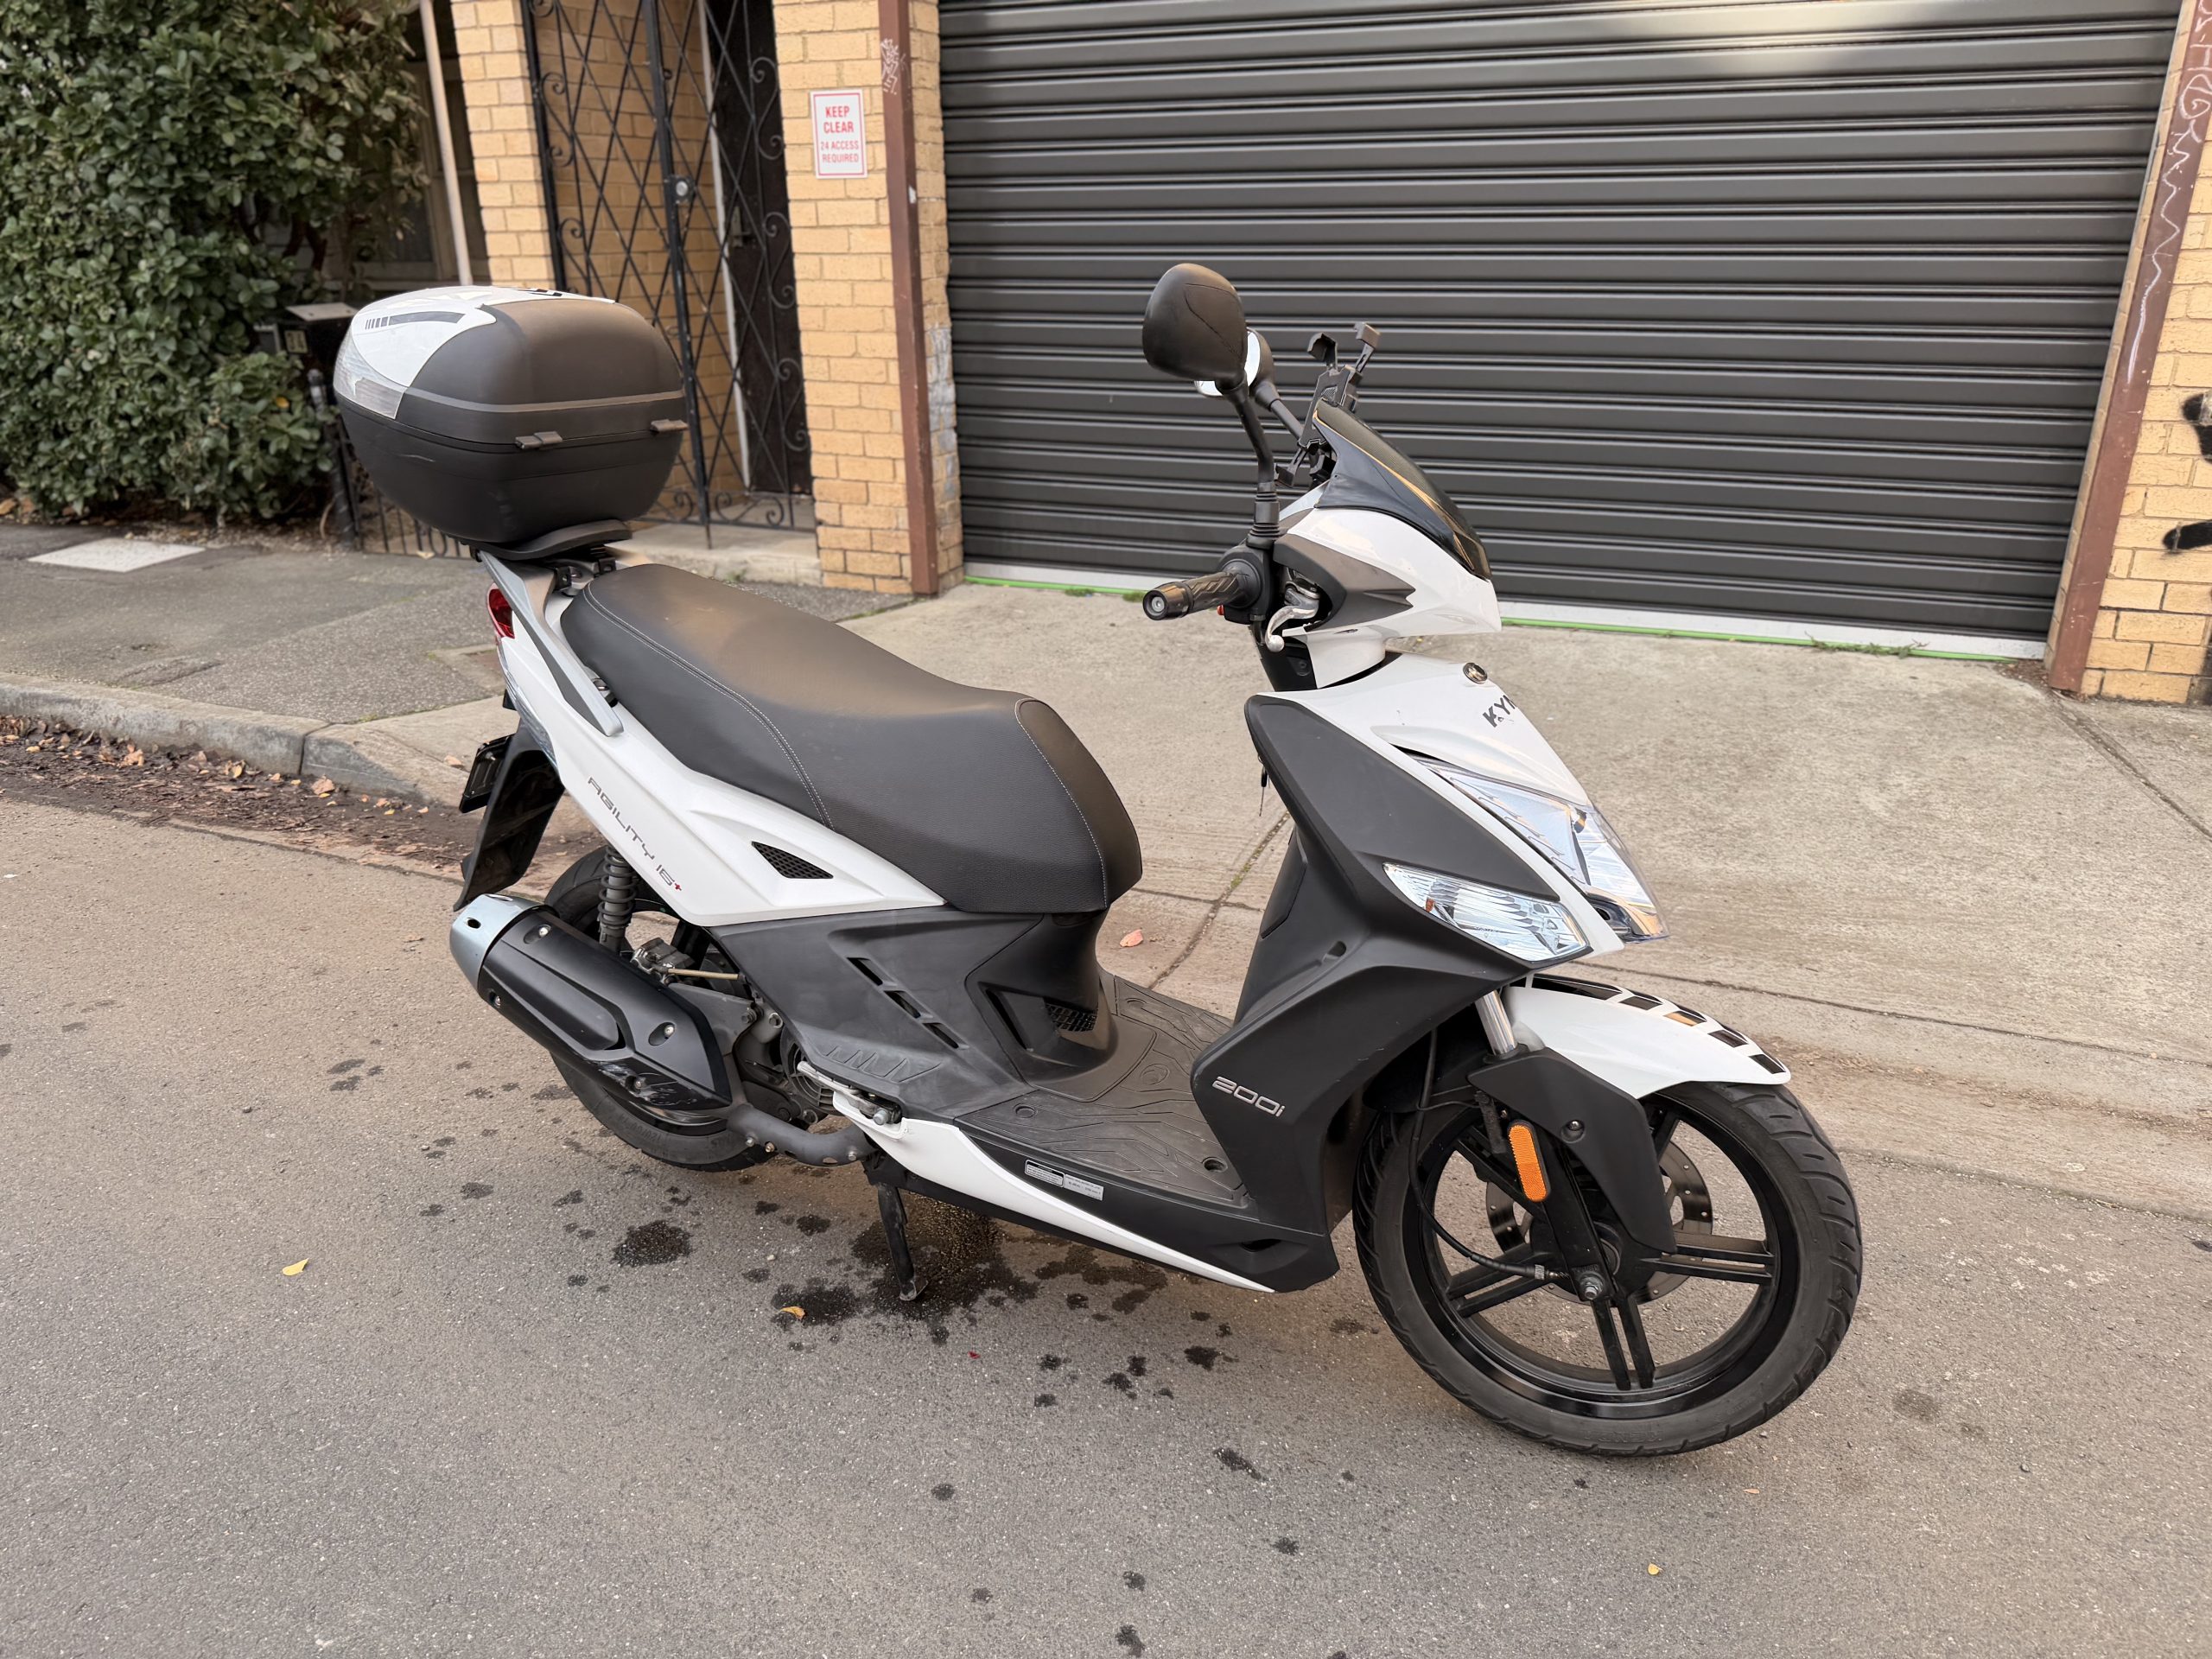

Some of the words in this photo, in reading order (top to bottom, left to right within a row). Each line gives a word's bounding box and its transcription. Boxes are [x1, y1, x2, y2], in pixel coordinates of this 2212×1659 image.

[825, 105, 849, 118] KEEP
[823, 121, 854, 133] CLEAR
[821, 141, 830, 150] 24
[831, 140, 859, 150] ACCESS
[822, 153, 859, 162] REQUIRED
[588, 776, 655, 861] AGILITY
[1211, 1076, 1286, 1117] 200i
